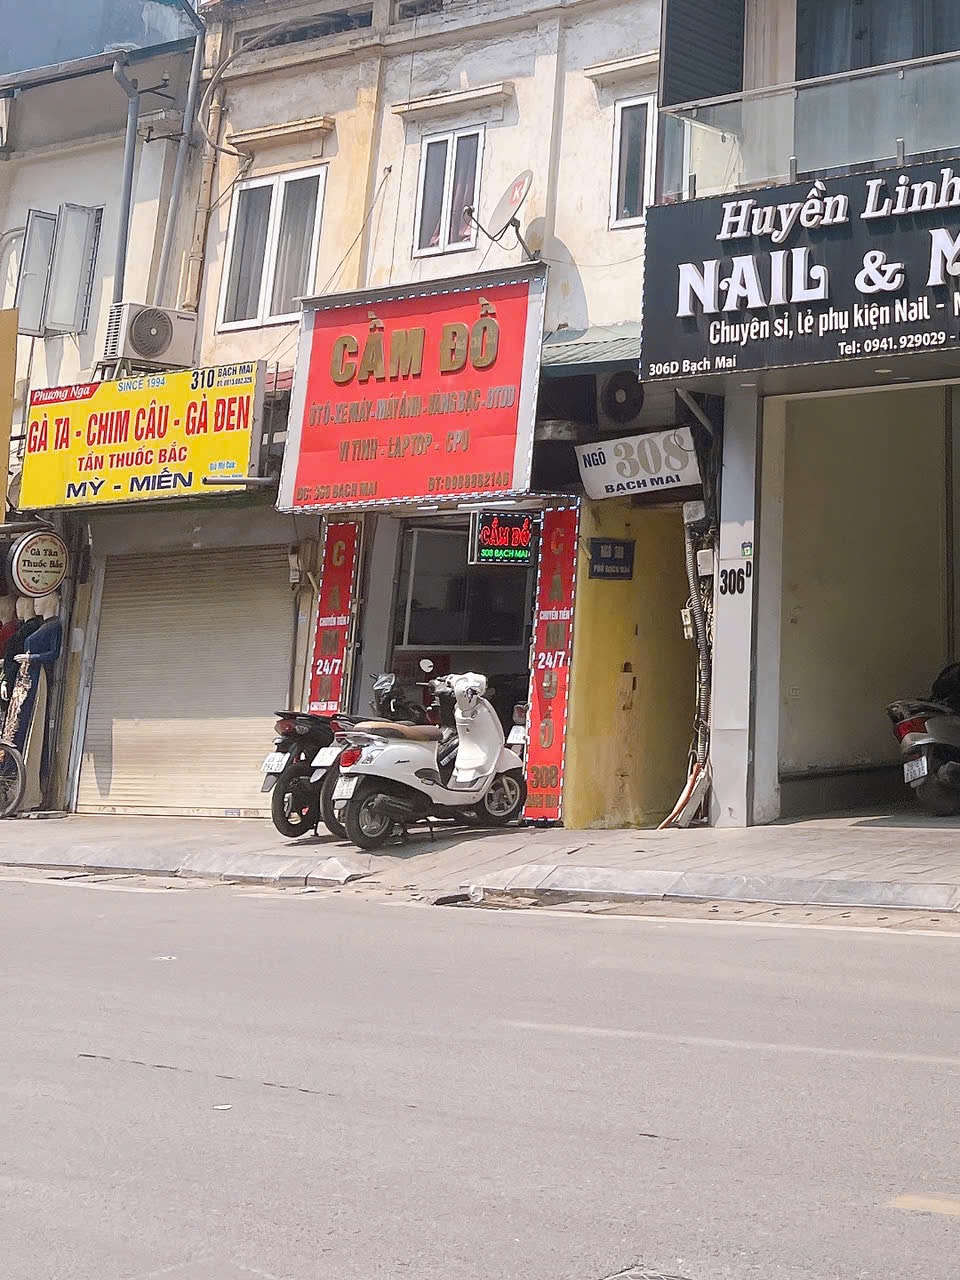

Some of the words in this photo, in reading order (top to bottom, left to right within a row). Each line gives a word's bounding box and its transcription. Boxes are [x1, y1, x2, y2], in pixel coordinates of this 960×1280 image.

[715, 179, 850, 243] Huyền
[676, 246, 829, 317] NAIL
[855, 250, 905, 293] &
[709, 318, 769, 347] Chuyên
[774, 313, 793, 339] sỉ,
[797, 309, 813, 334] lẻ
[819, 306, 849, 337] phụ
[853, 303, 890, 330] kiện
[895, 296, 930, 324] Nail
[331, 311, 425, 384] CẦM
[440, 296, 500, 376] ĐỒ
[838, 342, 861, 356] Tel:
[864, 331, 946, 353] 0941.929029
[191, 370, 215, 390] 310
[217, 366, 238, 378] BẠCH
[239, 364, 253, 374] MAI
[649, 361, 679, 376] 306D
[682, 357, 711, 375] Bạch
[715, 354, 737, 369] Mai
[33, 390, 69, 403] Phương
[70, 385, 91, 398] Nga
[117, 381, 144, 392] SINCE
[147, 377, 166, 388] 1994
[27, 414, 48, 453] GÀ
[54, 417, 70, 450] TA
[86, 410, 130, 446] CHIM
[134, 400, 170, 441] CÂU
[185, 393, 208, 436] GÀ
[213, 395, 251, 432] ĐEN
[109, 445, 153, 467] THUỐC
[158, 440, 188, 463] BẮC
[582, 447, 607, 468] NGÕ
[613, 433, 690, 479] 308
[66, 476, 105, 499] MỲ
[129, 466, 194, 492] MIẾN
[604, 479, 648, 494] BẠCH
[649, 474, 681, 487] MAI
[316, 659, 341, 676] 24/7
[537, 651, 565, 669] 24/7
[531, 765, 558, 789] 308
